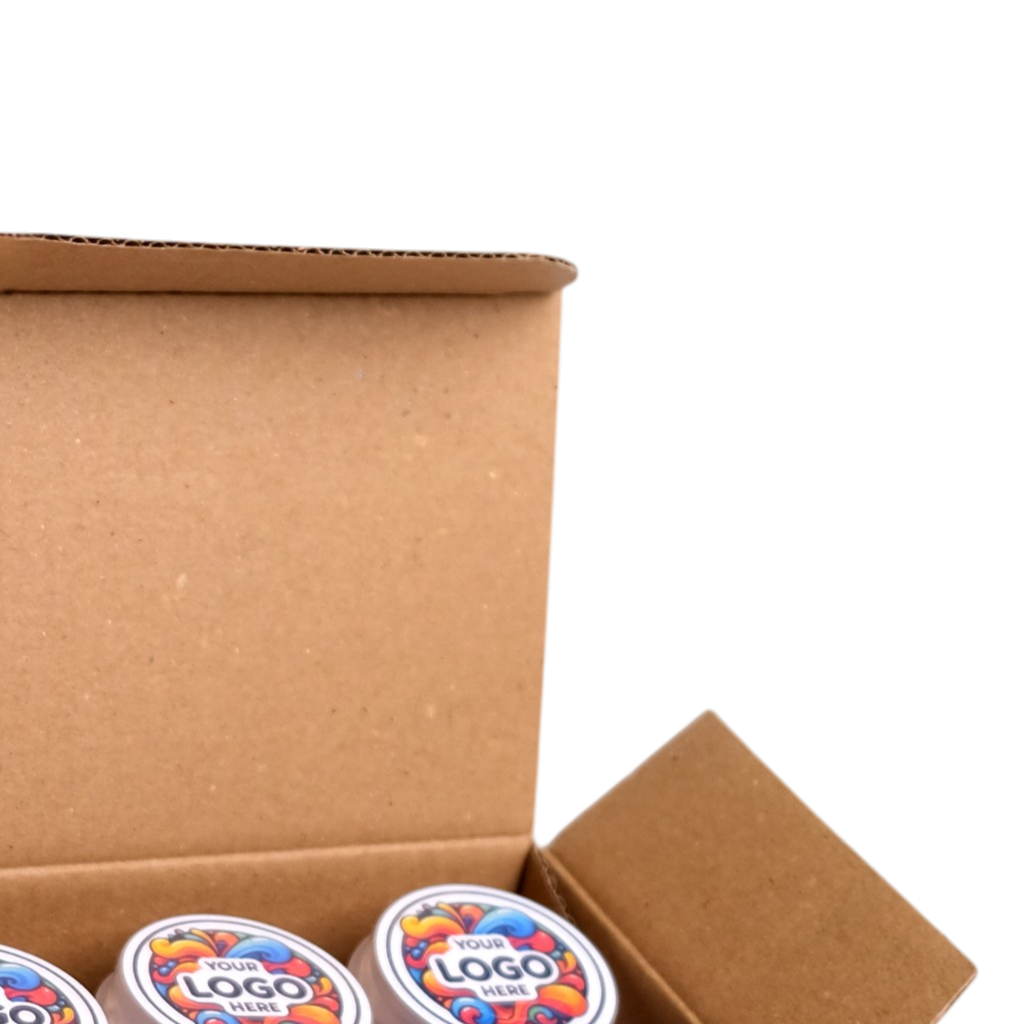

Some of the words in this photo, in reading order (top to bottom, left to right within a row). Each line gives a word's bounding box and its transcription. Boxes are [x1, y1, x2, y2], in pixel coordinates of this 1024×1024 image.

[454, 938, 507, 950] YOUR
[207, 961, 259, 973] YOUR
[437, 956, 553, 983] LOGO
[184, 977, 307, 999] LOGO
[480, 984, 530, 997] HERE
[229, 1001, 281, 1013] HERE
